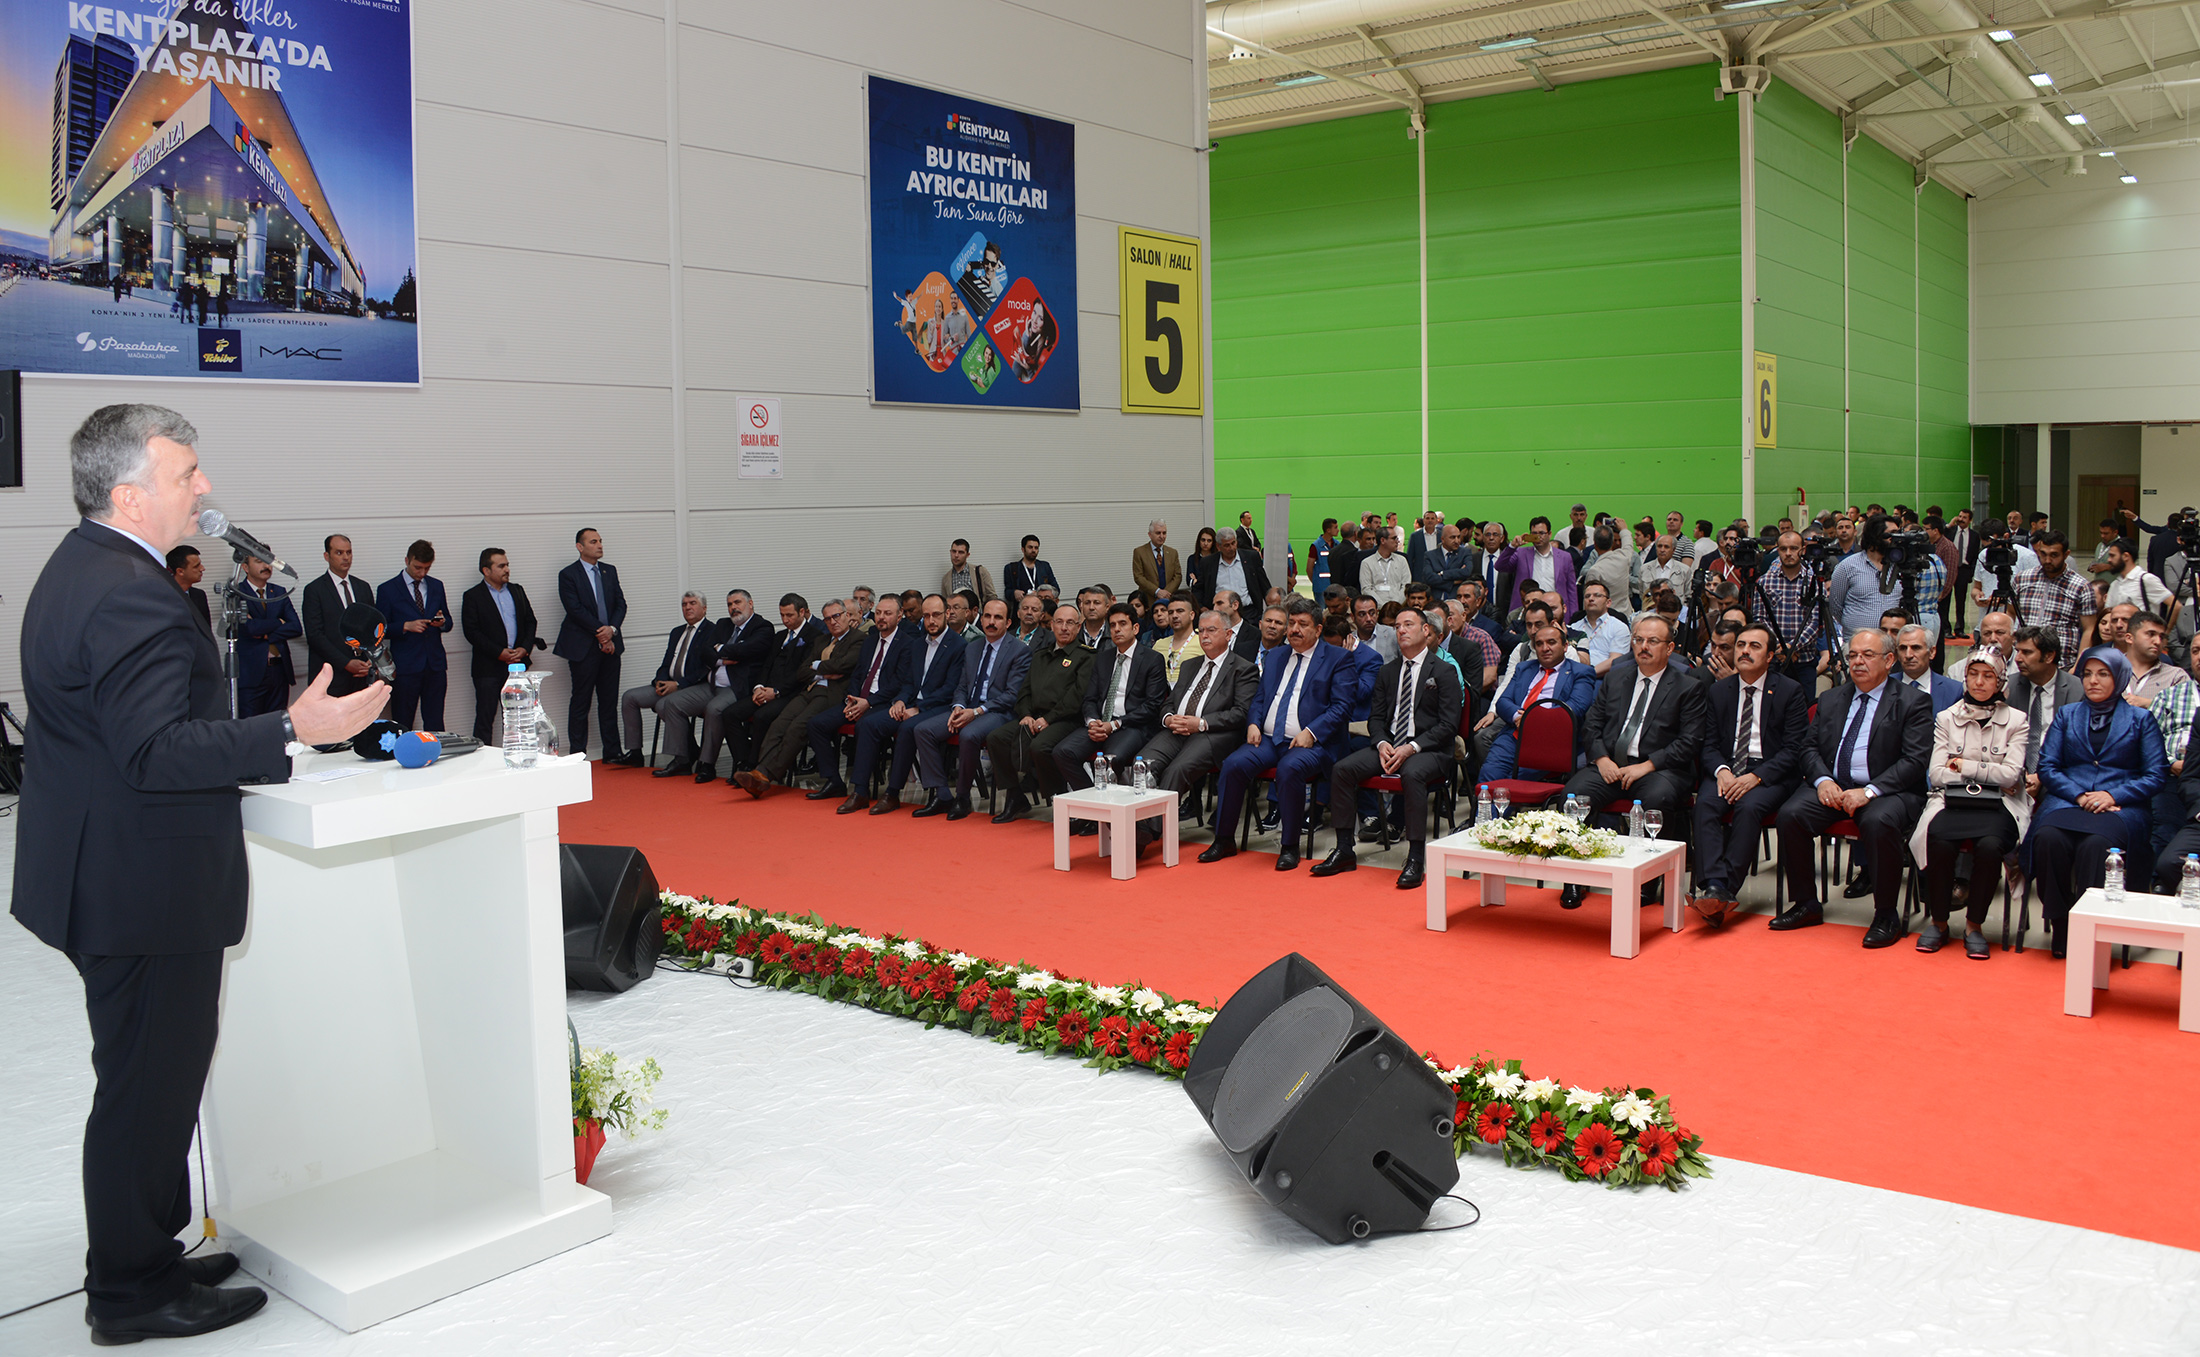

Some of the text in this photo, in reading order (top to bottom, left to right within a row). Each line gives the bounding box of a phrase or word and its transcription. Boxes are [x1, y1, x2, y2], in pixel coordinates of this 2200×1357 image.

[68, 1, 333, 72] KENTPLAZA'DA
[130, 42, 283, 93] YAŞANIR
[137, 121, 185, 174] KENTPLAZA
[959, 121, 1010, 143] KENTPLAZA
[248, 145, 288, 206] KENTPLAZA
[926, 145, 1031, 181] BU KENT'İN
[906, 170, 1048, 210] AYRICALIKLARI
[933, 199, 1025, 228] Tam Sana Göre
[1130, 246, 1162, 267] SALON
[1169, 253, 1193, 272] HALL
[91, 309, 137, 317] KONYA'NIN
[278, 319, 328, 327] KENTPLAZA'DA
[1007, 299, 1032, 311] moda
[99, 336, 179, 353] Paşabahçe
[1144, 279, 1184, 395] 5
[203, 353, 238, 363] Tchibo
[1761, 379, 1771, 439] 6
[741, 432, 759, 446] SİGARA
